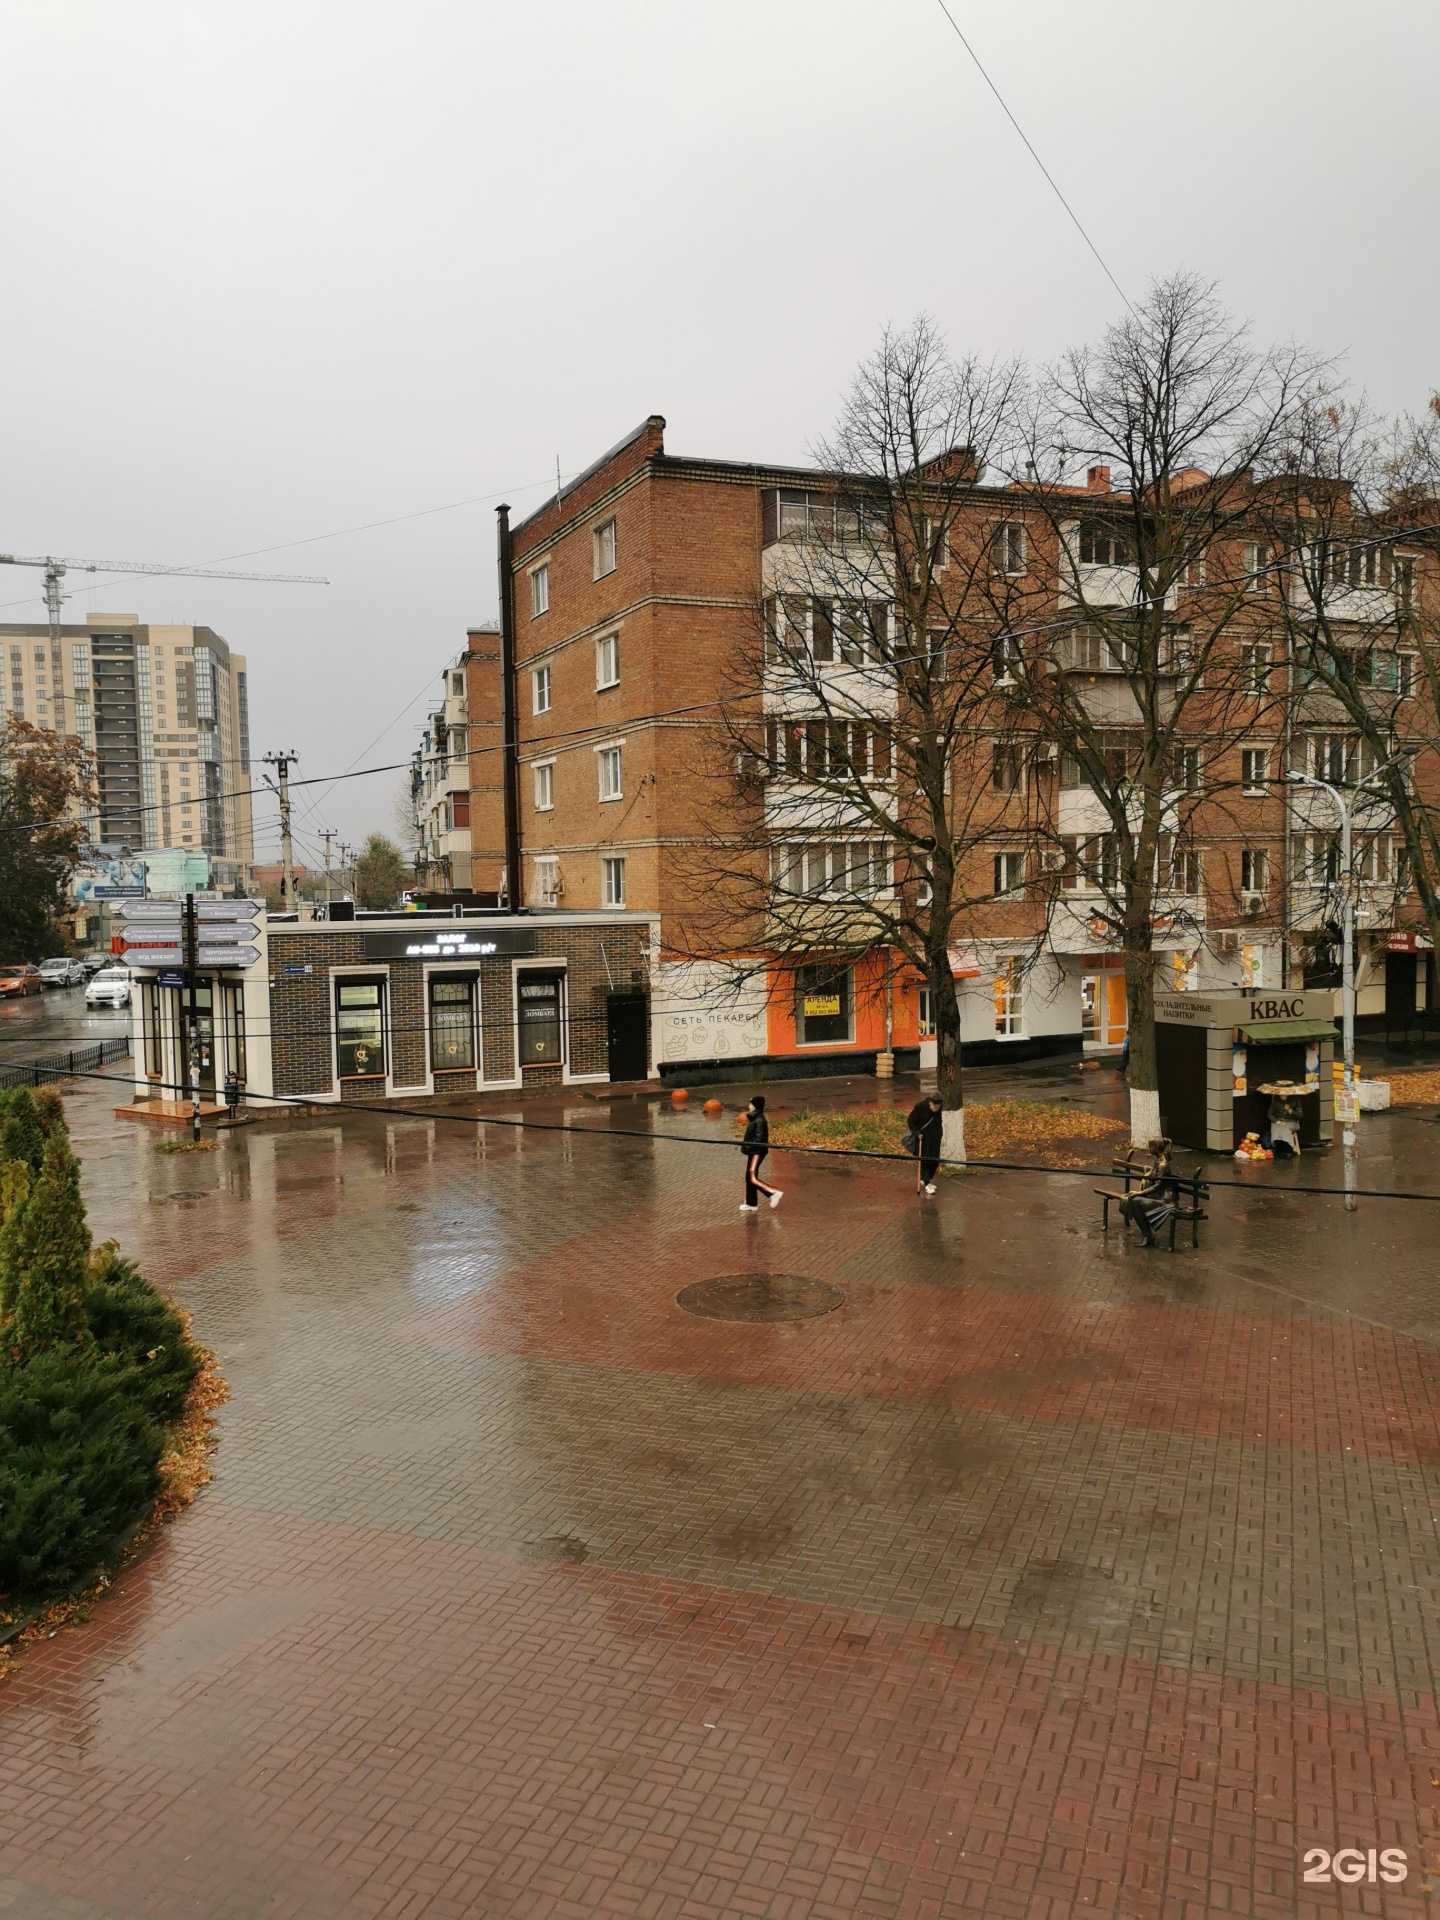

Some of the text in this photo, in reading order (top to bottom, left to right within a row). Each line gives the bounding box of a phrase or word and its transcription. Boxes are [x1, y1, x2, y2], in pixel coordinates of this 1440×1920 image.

[1163, 1009, 1196, 1020] НАПИТКИ
[1250, 999, 1305, 1020] КВАС
[673, 1016, 702, 1026] СЕТЬ
